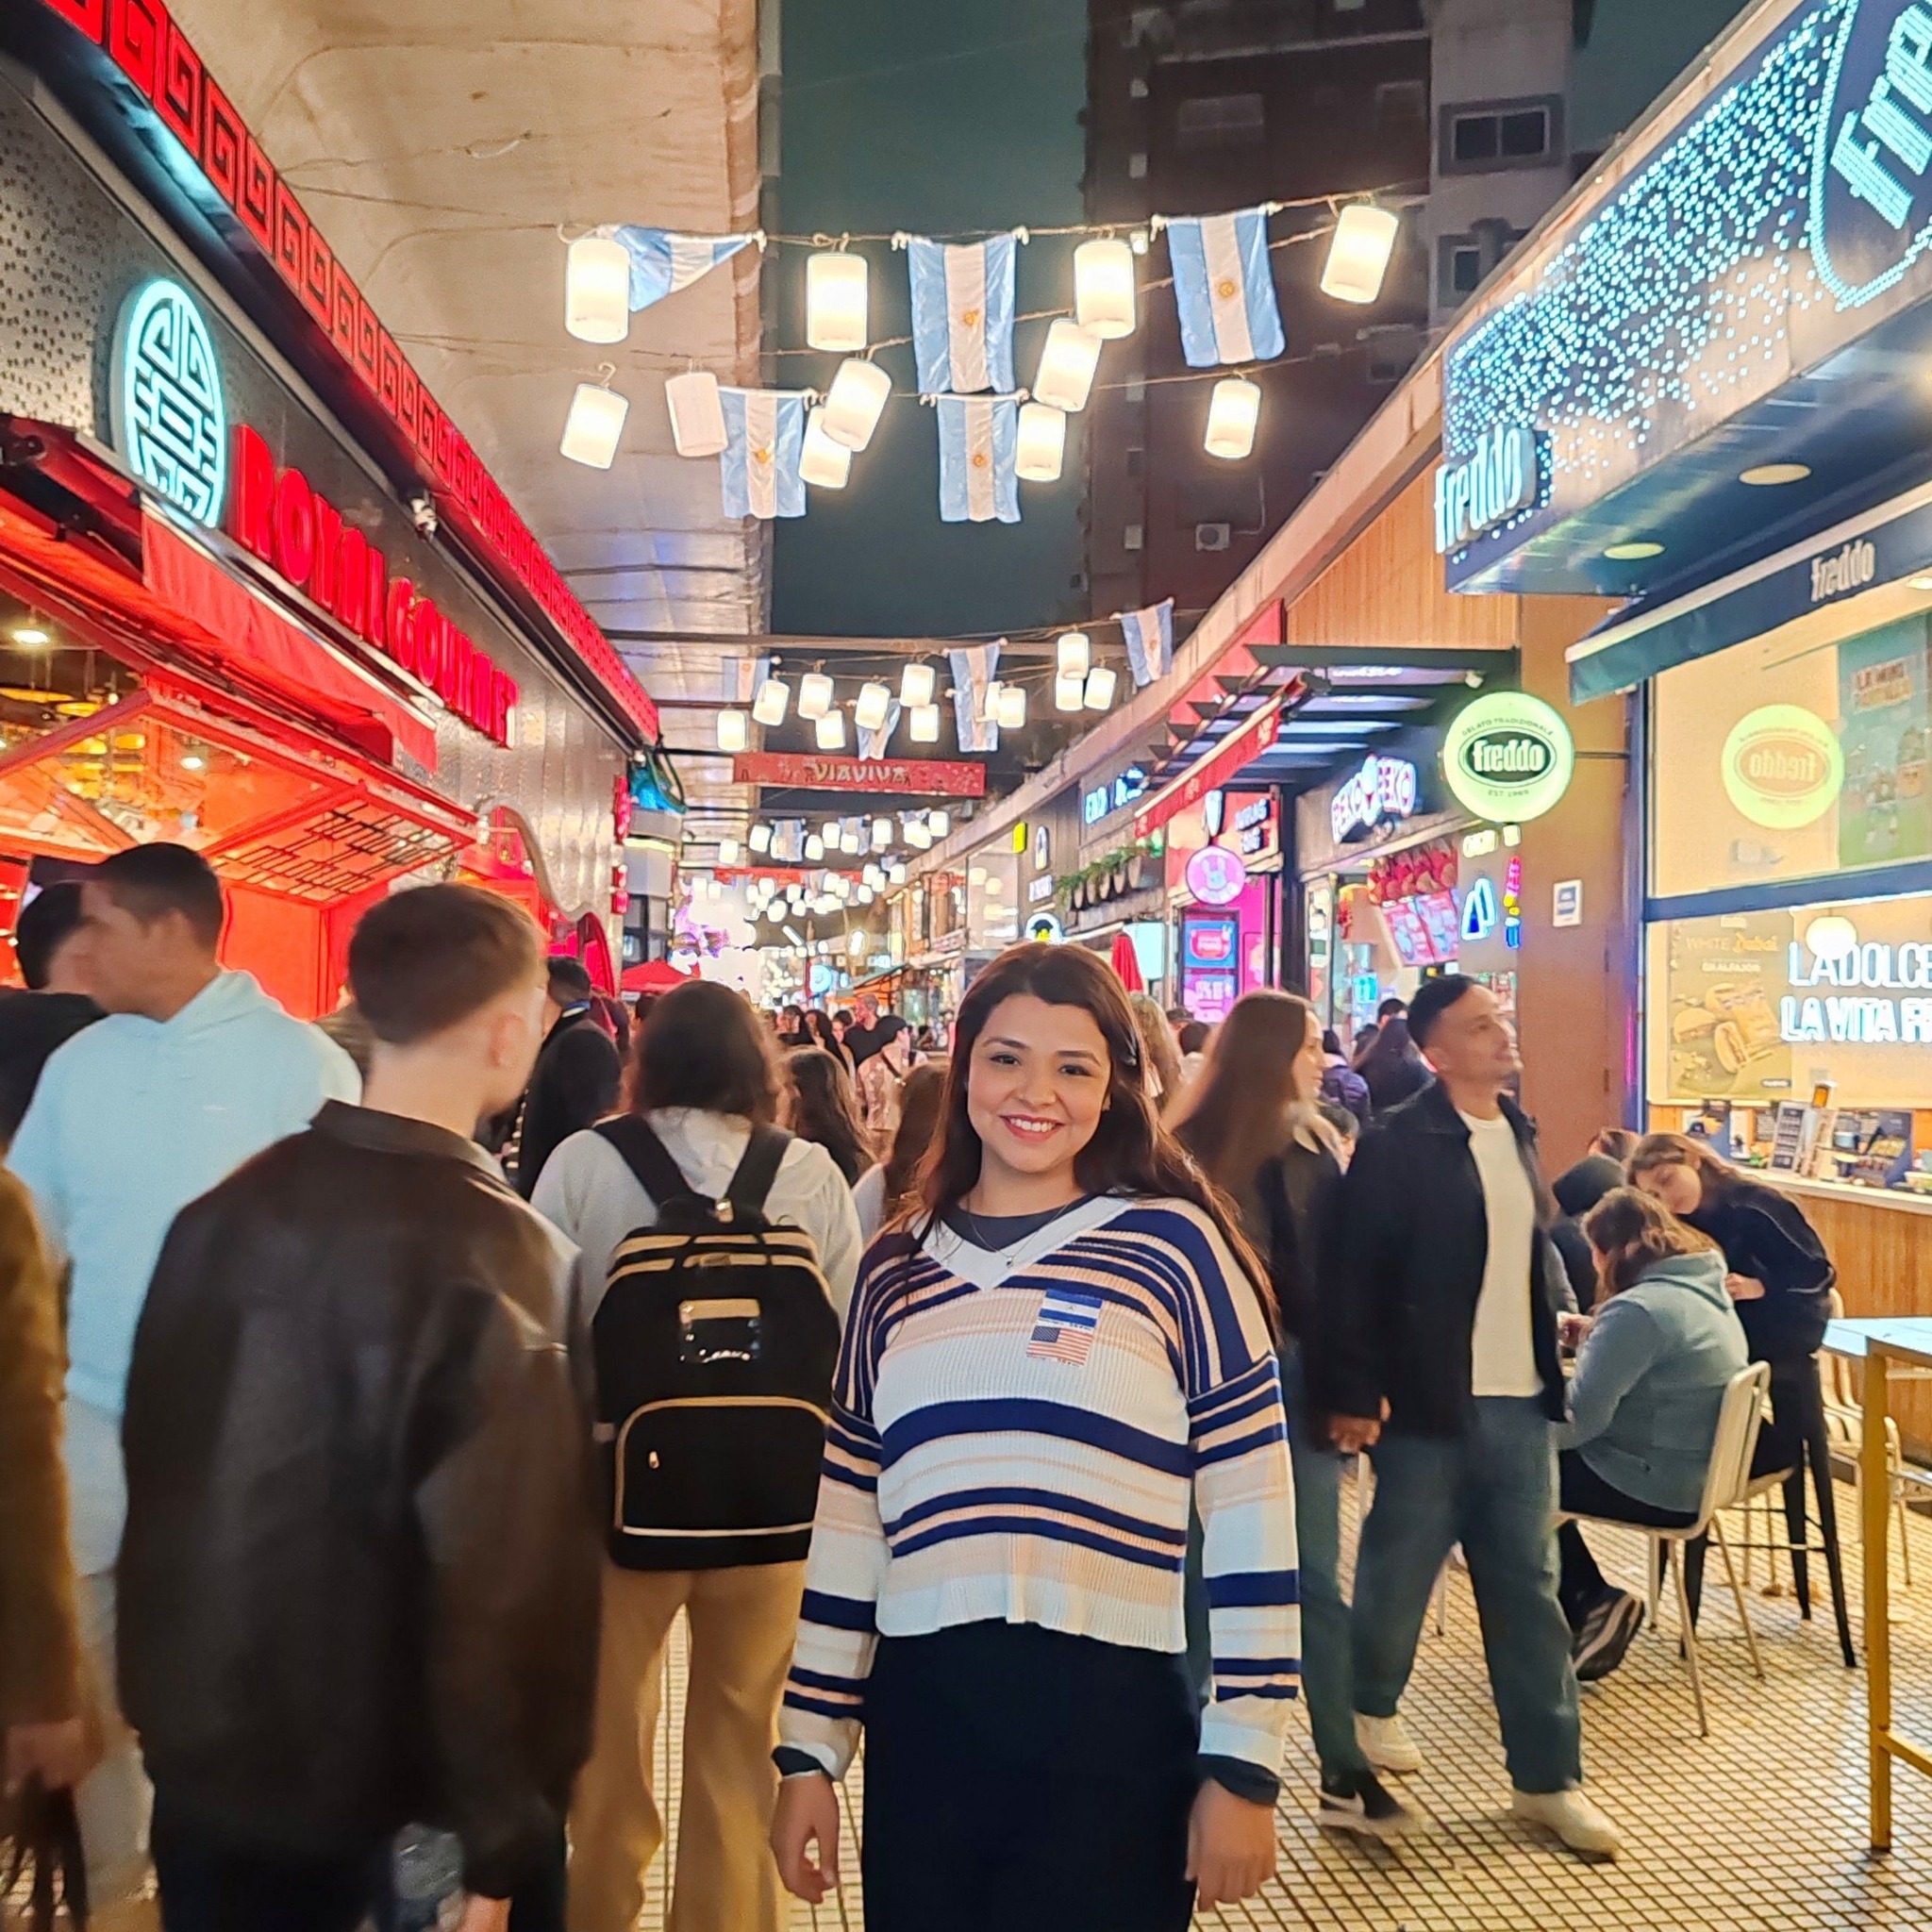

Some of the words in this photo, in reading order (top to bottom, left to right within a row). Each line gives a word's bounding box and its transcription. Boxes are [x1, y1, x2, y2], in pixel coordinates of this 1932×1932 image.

[1434, 424, 1522, 554] freddo
[1810, 539, 1875, 602] freddo
[1472, 739, 1546, 773] freddo
[1779, 995, 1825, 1042] LA
[1825, 996, 1899, 1043] VITA
